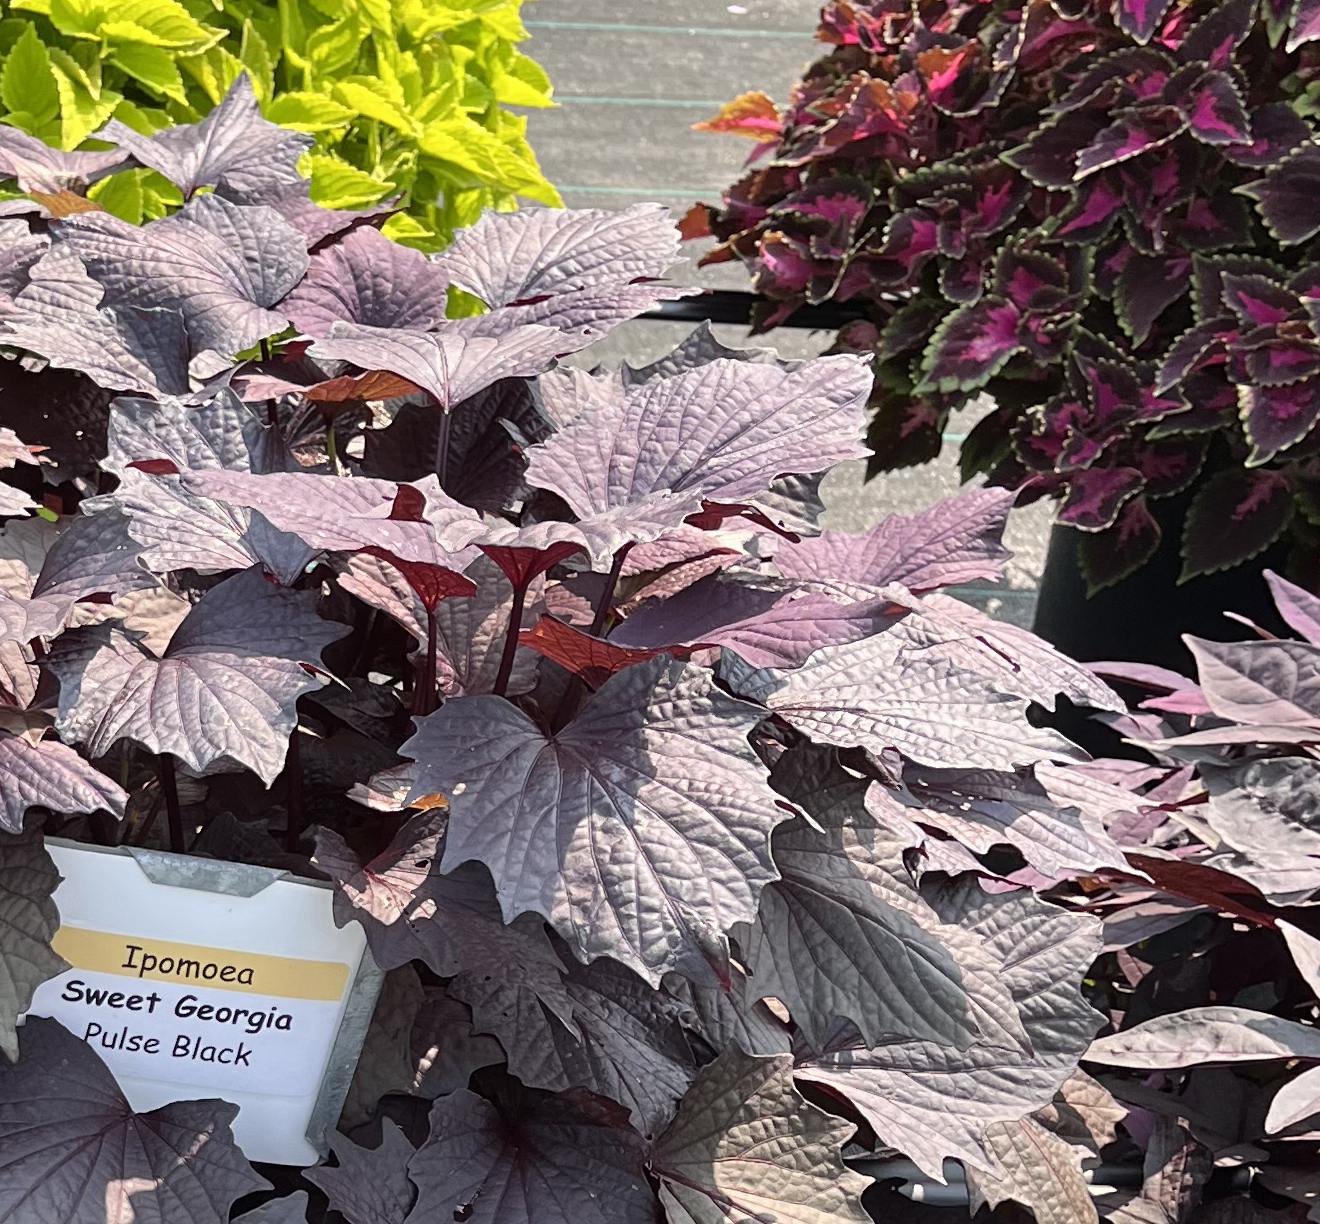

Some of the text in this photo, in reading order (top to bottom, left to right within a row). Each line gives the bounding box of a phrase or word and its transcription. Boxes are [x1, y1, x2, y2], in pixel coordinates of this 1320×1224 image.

[121, 944, 255, 985] Ipomoea
[61, 980, 293, 1034] Sweet Georgia
[83, 1022, 253, 1067] Pulse Black
